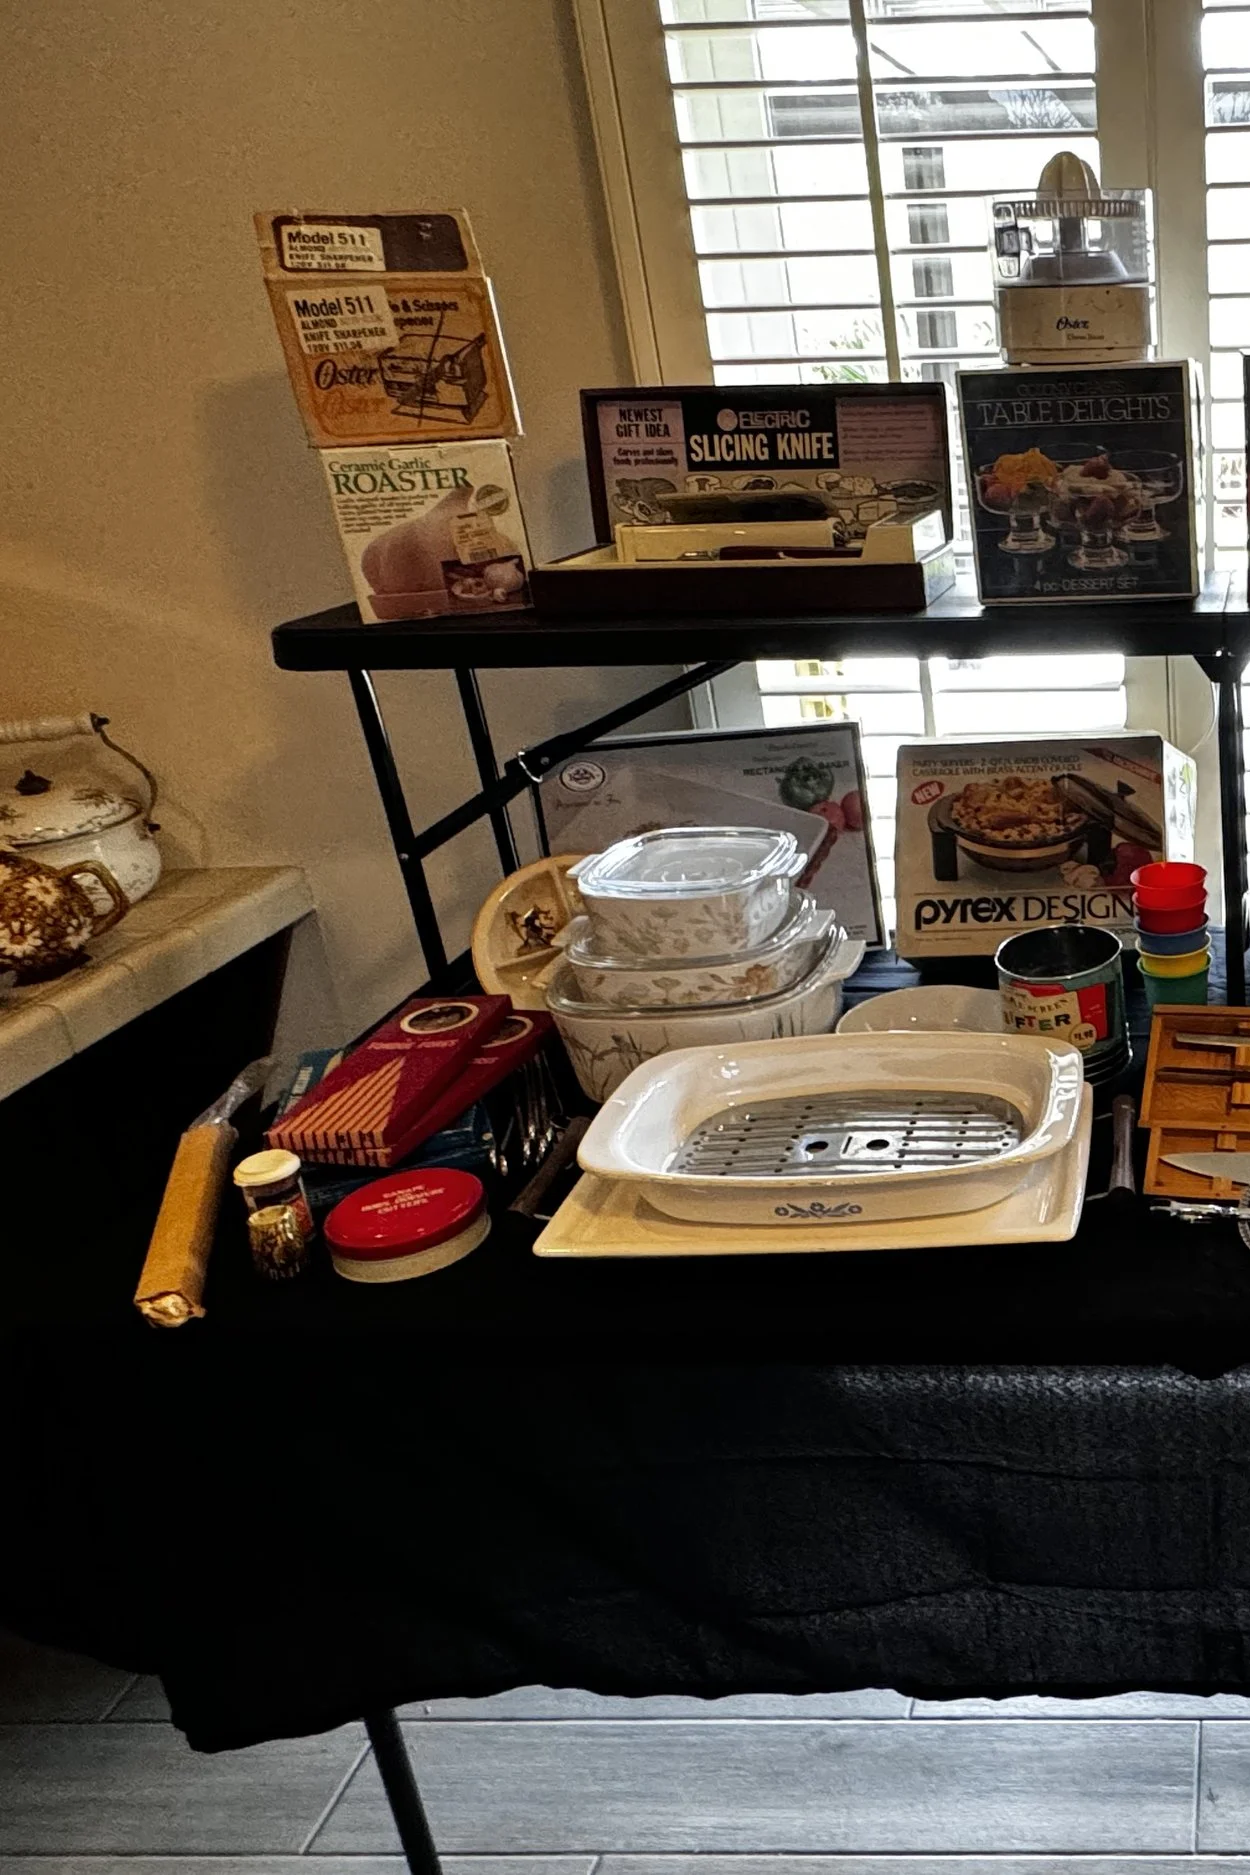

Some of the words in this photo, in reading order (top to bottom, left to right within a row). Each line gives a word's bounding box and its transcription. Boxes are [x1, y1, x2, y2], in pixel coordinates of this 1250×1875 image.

[288, 231, 335, 245] Model
[337, 232, 366, 247] 511
[288, 253, 315, 261] KNIFE
[319, 253, 374, 263] SHARPENER
[294, 298, 344, 319] Model
[345, 295, 375, 316] 511
[301, 317, 338, 331] ALMOND
[1056, 316, 1090, 331] Oster
[302, 330, 332, 343] KNIFE
[333, 327, 387, 341] SHARPENER
[315, 358, 379, 391] Oster
[619, 408, 664, 423] NEWEST
[977, 400, 1054, 427] TABLE
[1057, 395, 1172, 423] DELIGHTS
[739, 410, 811, 430] ELECTRIC
[616, 424, 640, 438] GIFT
[645, 423, 672, 438] IDEA
[689, 433, 769, 463] SLICING
[776, 431, 835, 461] KNIFE
[327, 460, 386, 473] Ceramic
[388, 457, 431, 471] Garlic
[331, 467, 475, 495] ROASTER
[1061, 578, 1115, 591] DESSERT
[817, 760, 850, 770] BAKER
[912, 767, 962, 777] CASSEROLE
[963, 767, 986, 776] WITH
[987, 766, 1016, 775] BRASS
[914, 782, 942, 804] NEW
[914, 896, 1017, 931] pyrex
[1023, 893, 1136, 922] DESIGN
